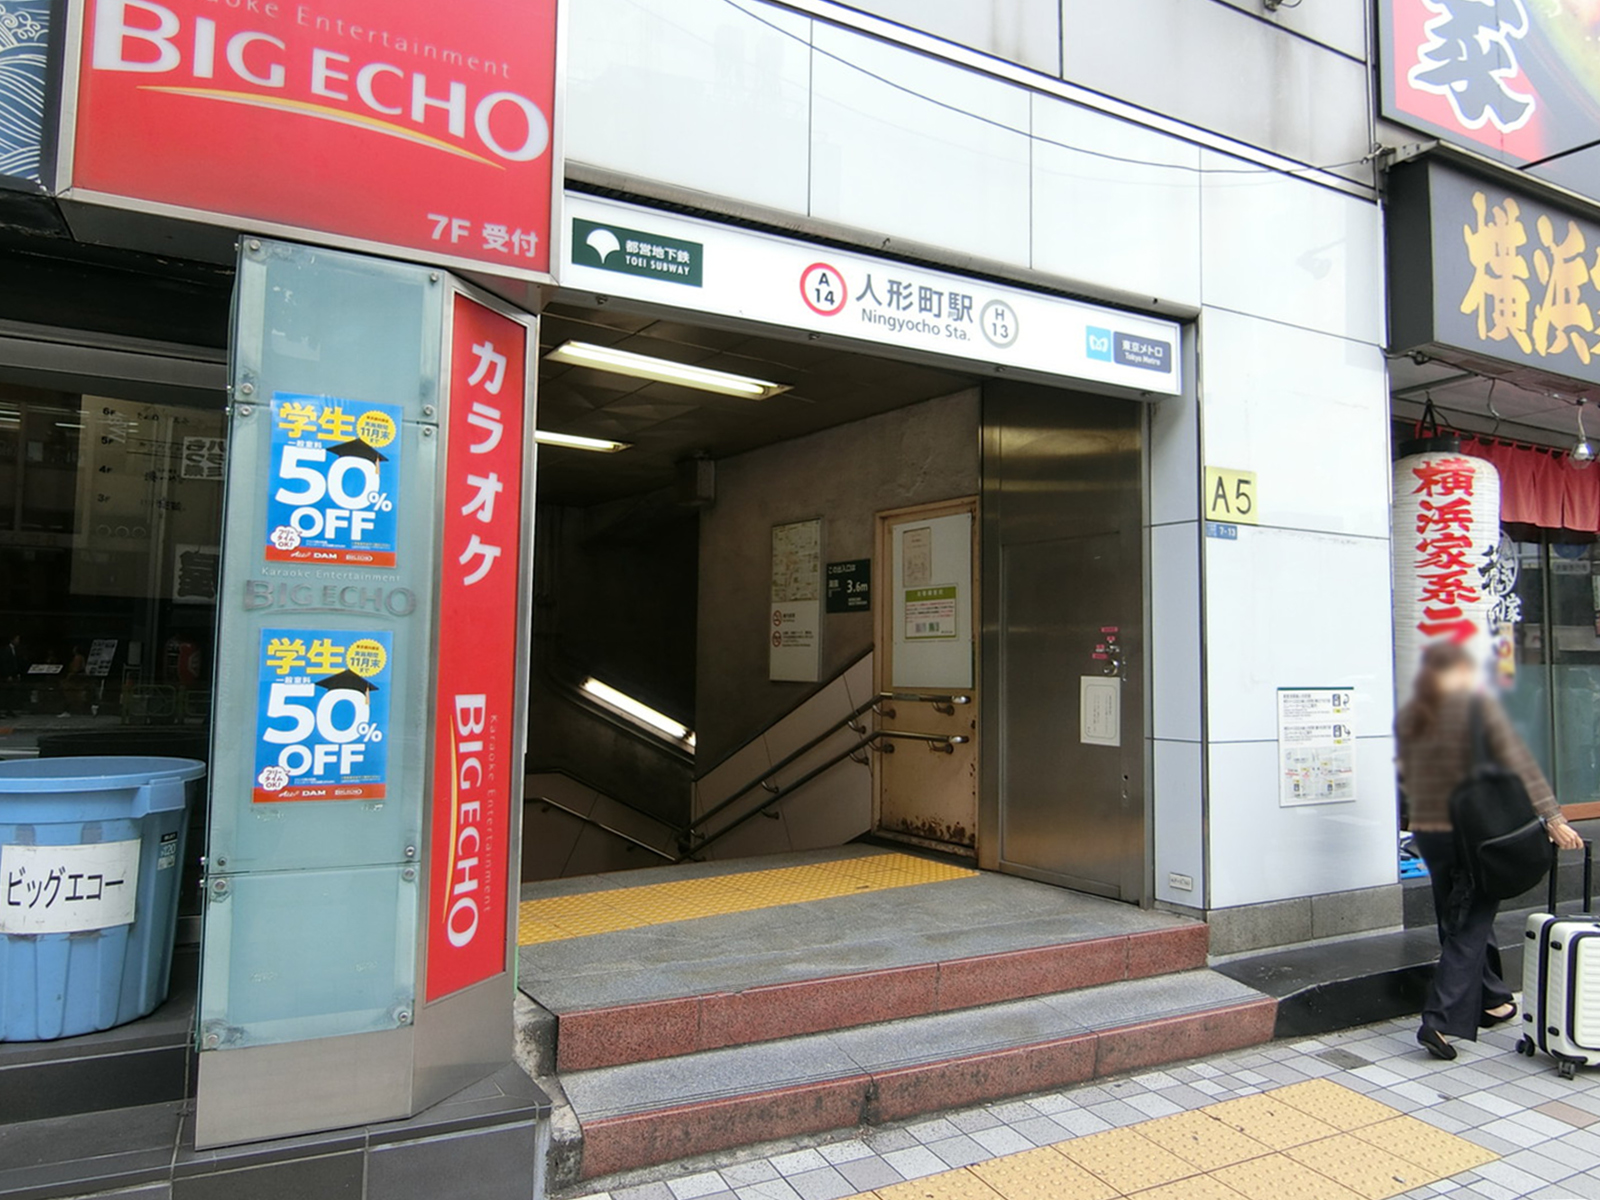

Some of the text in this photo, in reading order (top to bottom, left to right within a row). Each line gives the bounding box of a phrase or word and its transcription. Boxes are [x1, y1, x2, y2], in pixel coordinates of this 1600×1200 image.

[297, 5, 511, 79] Entertainment
[92, 0, 549, 162] BIG ECHO
[427, 213, 538, 258] 7F 受付
[625, 239, 690, 265] 都営地下鉄
[625, 255, 690, 276] TOEI SUBWAY
[818, 272, 831, 287] A
[1460, 191, 1600, 364] 横浜
[814, 287, 836, 306] 14
[855, 273, 974, 324] 人形町駅
[994, 307, 1006, 322] H
[861, 308, 971, 342] Ningyocho Sta.
[991, 322, 1010, 340] 13
[278, 401, 357, 443] 学生
[459, 340, 507, 587] カラオケ
[1212, 475, 1252, 516] A5
[290, 507, 377, 541] OFF
[313, 551, 338, 560] DAM
[262, 566, 401, 582] Karaoke Entertainment
[846, 579, 868, 593] 3.6m
[243, 579, 417, 617] BIG ECHO
[266, 637, 347, 675] 学生
[350, 657, 381, 668] 11月末
[278, 744, 365, 776] OFF
[447, 693, 486, 948] BIG ECHO
[483, 714, 498, 912] Karaoke Entertainment
[8, 866, 124, 909] ビッグエコー
